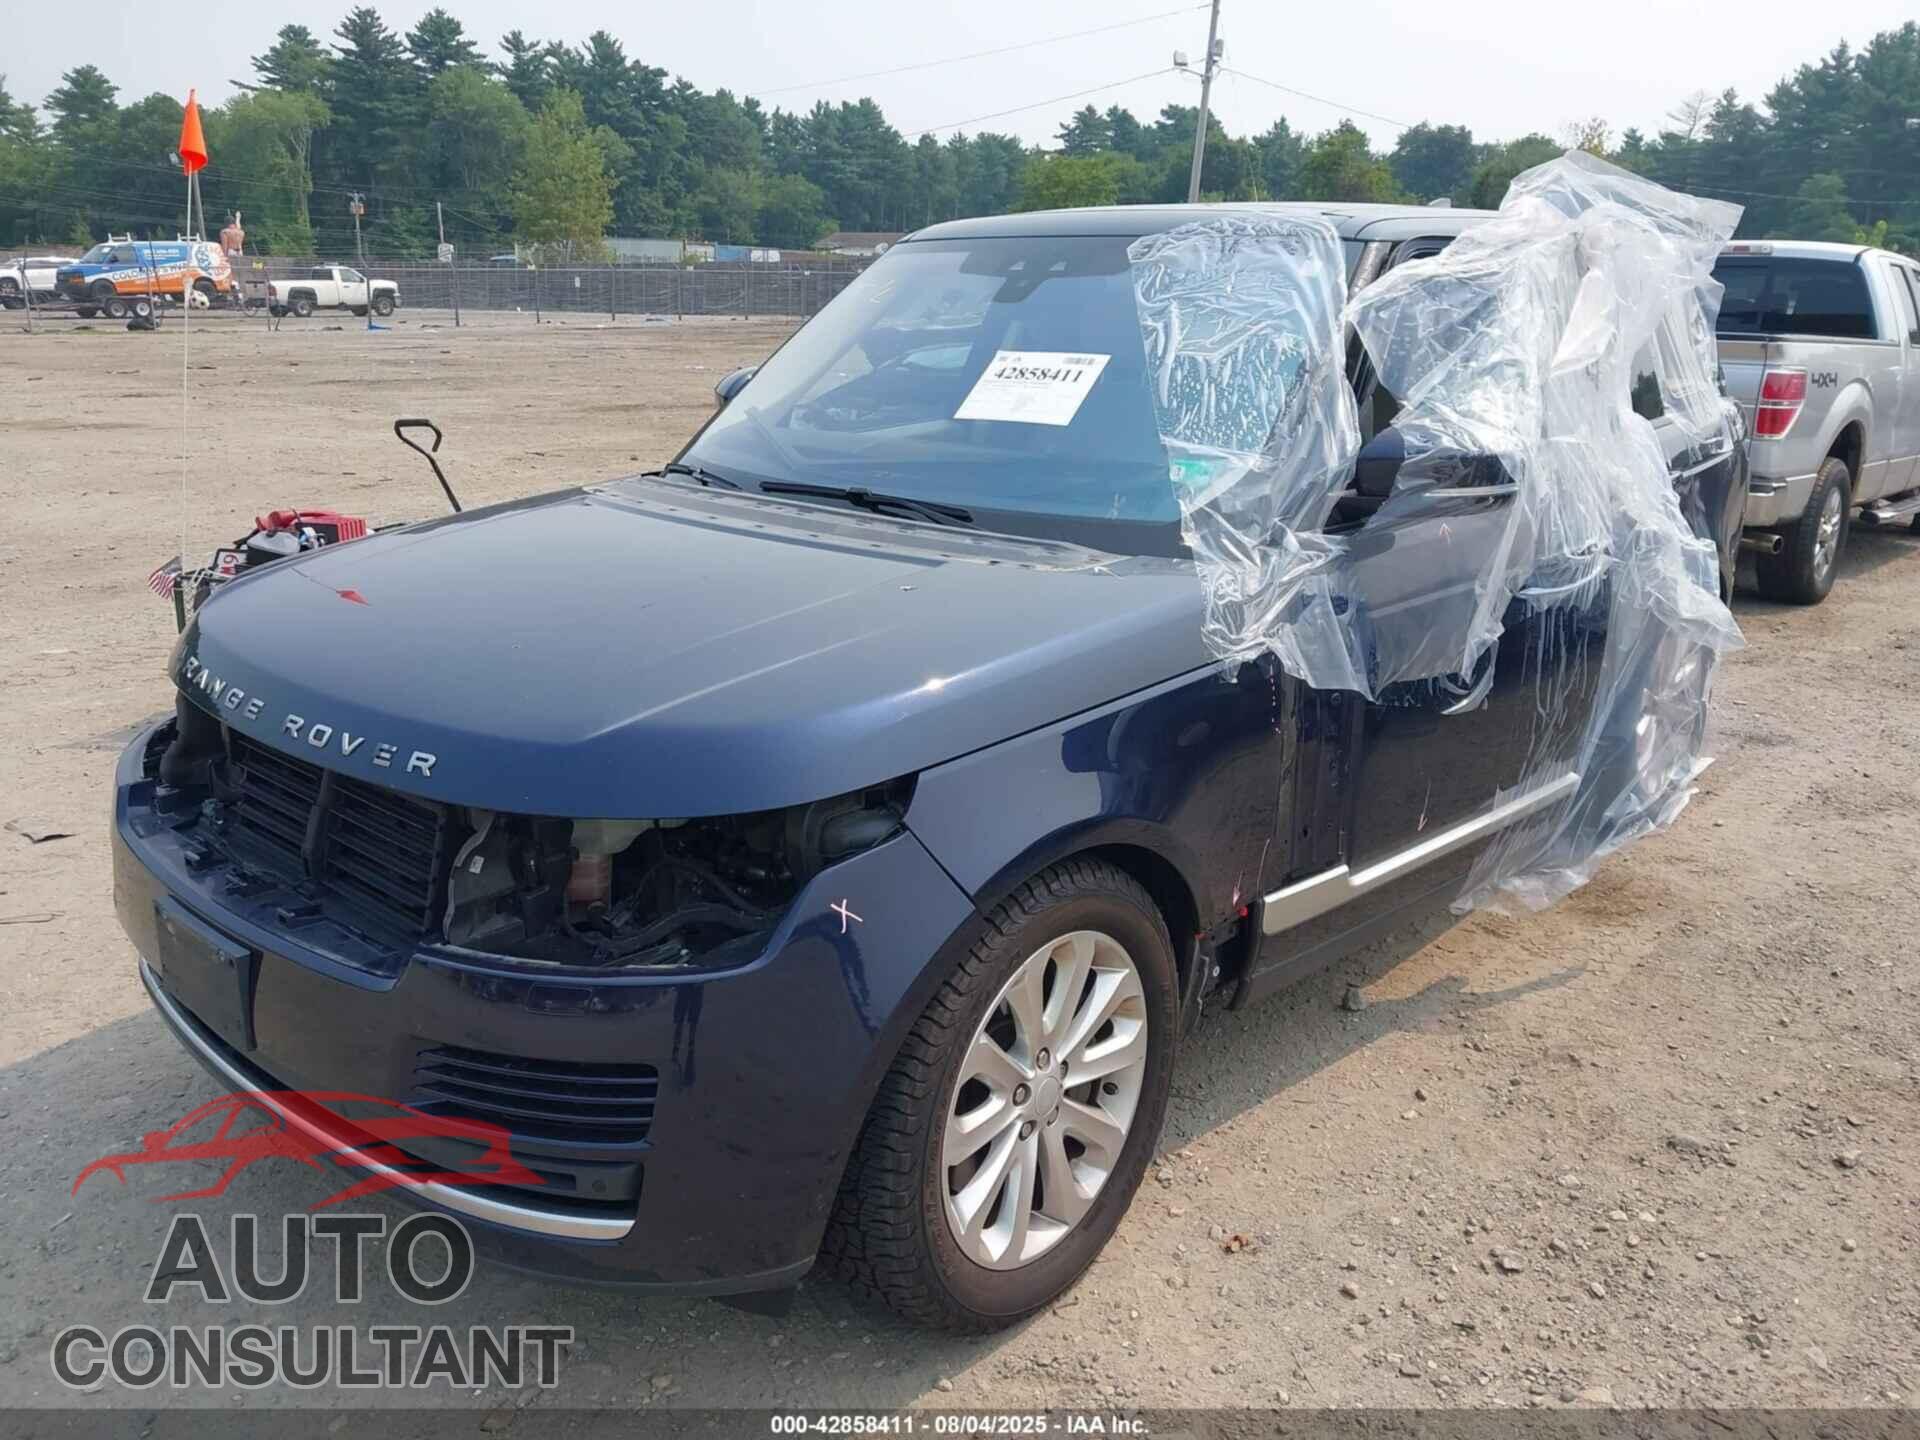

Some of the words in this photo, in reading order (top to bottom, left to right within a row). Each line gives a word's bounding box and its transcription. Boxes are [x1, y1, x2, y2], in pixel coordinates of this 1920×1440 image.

[994, 366, 1084, 383] 42858411
[181, 656, 265, 721] RANGE
[281, 713, 437, 777] ROVER
